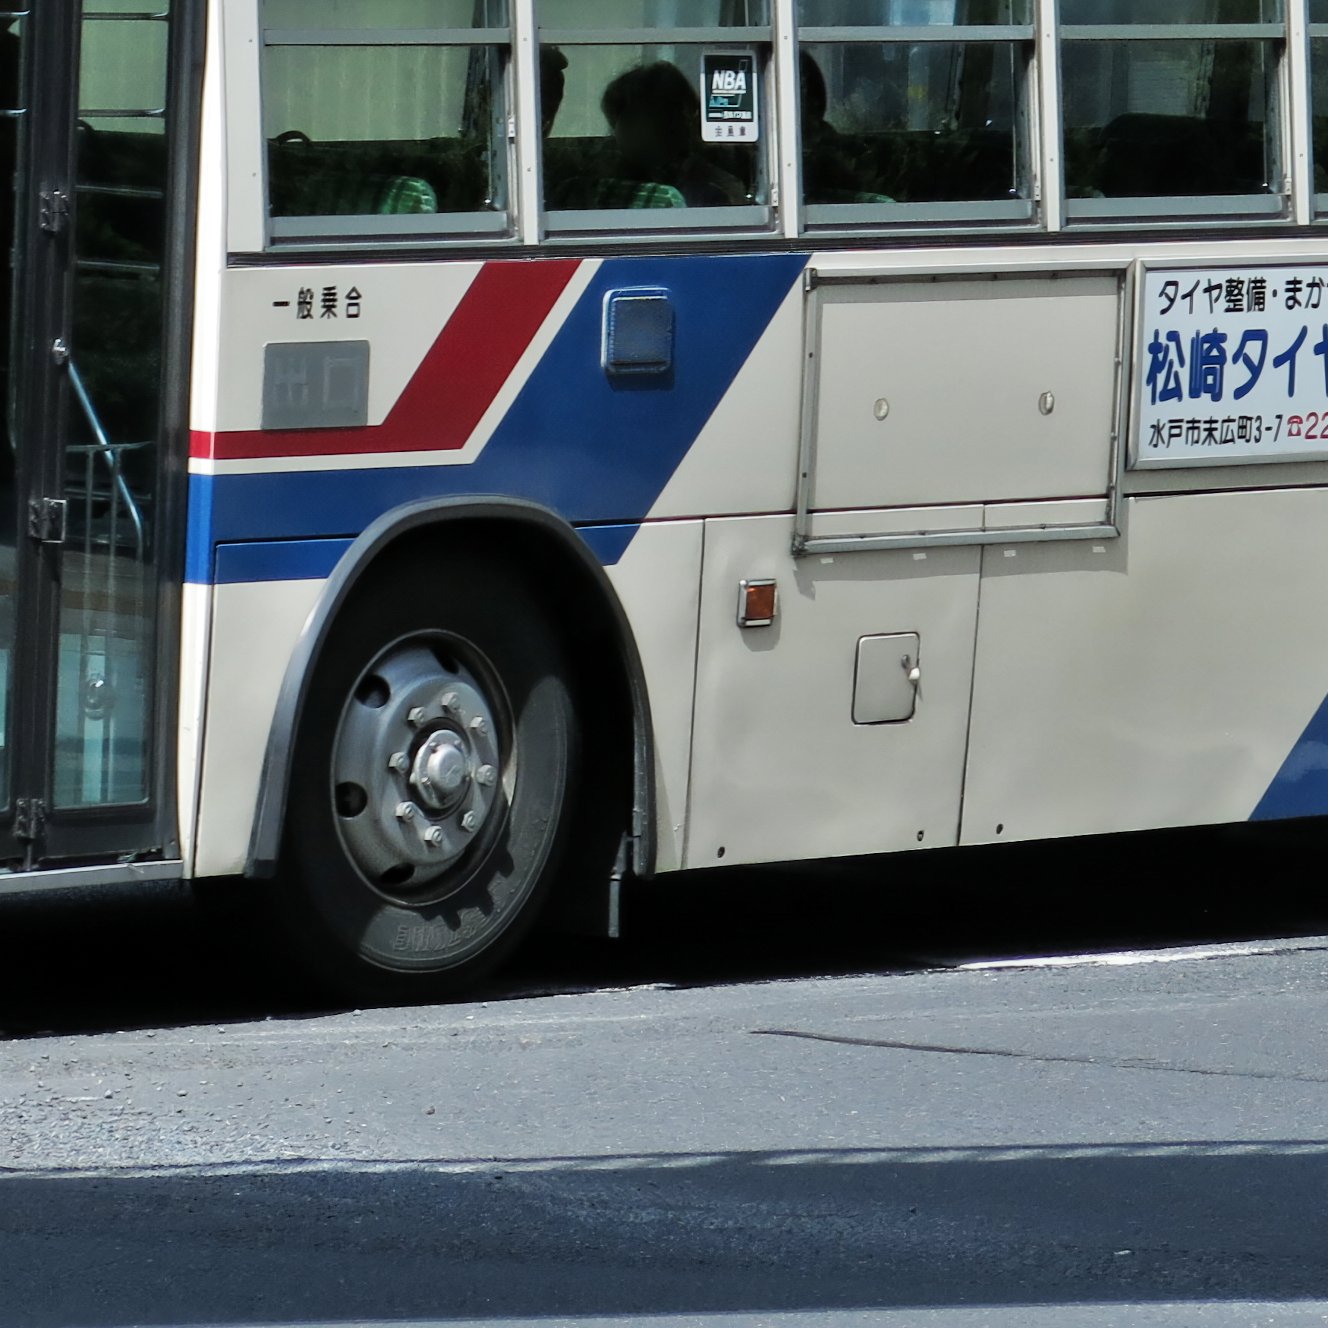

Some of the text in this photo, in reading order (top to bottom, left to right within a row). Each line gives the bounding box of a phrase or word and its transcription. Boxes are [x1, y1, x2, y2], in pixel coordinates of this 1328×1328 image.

[712, 69, 747, 91] NBA
[272, 285, 362, 320] 一般乗合
